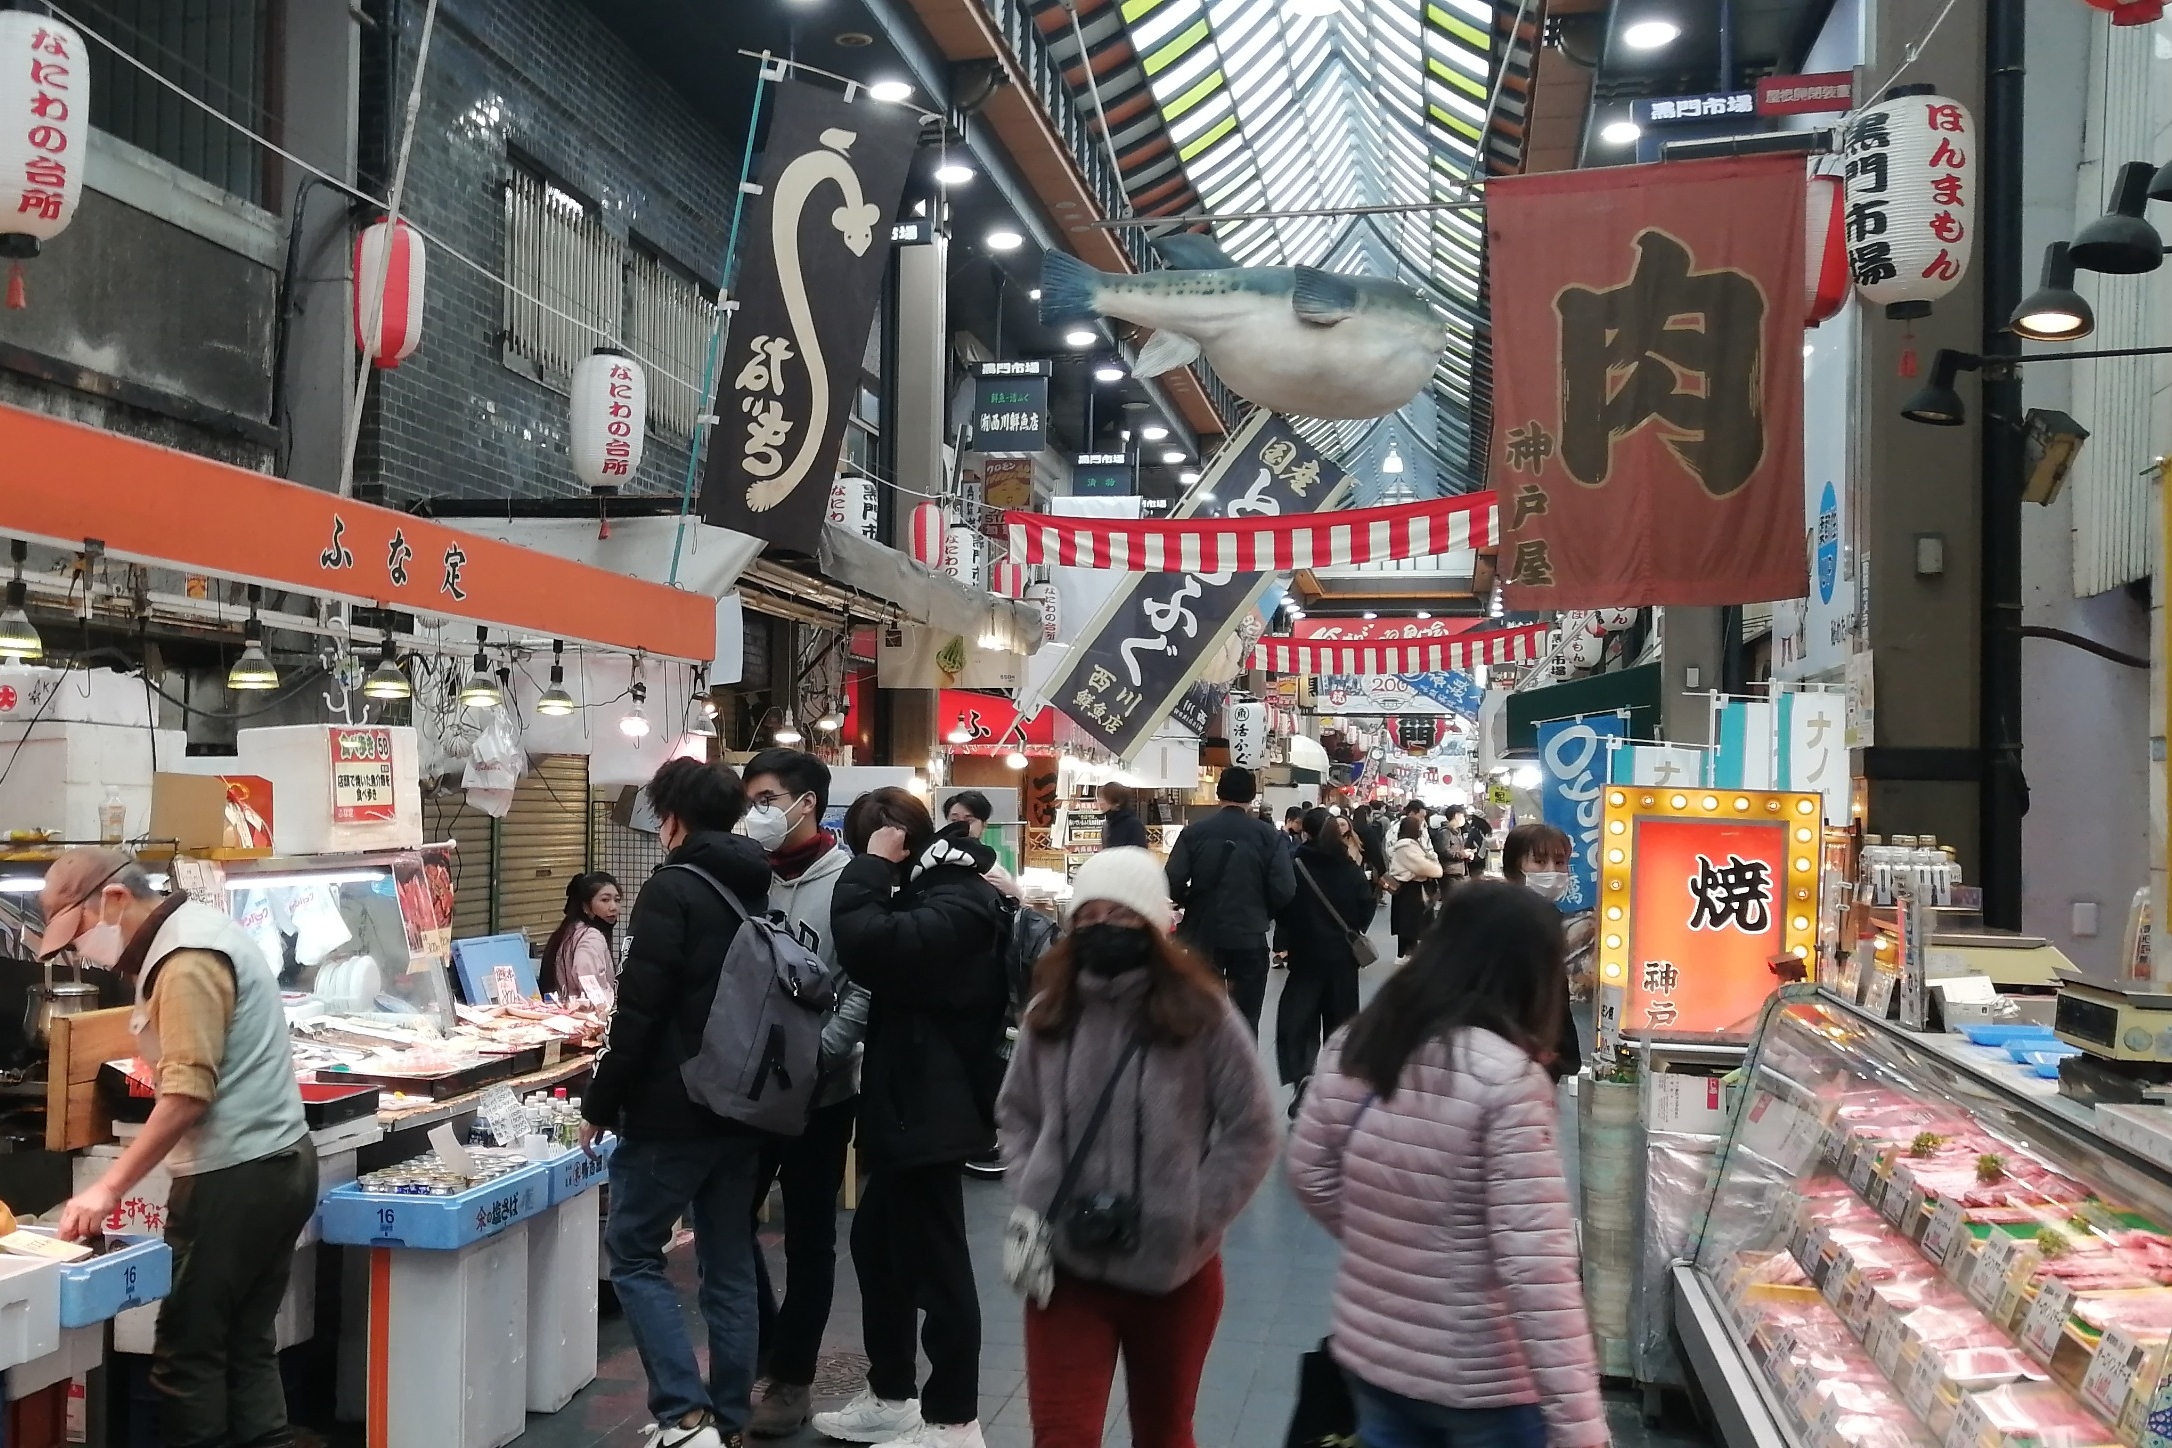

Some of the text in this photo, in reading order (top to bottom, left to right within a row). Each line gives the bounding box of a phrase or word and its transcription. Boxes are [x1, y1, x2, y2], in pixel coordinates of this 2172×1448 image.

[18, 27, 70, 221] なにわの台所
[1651, 94, 1754, 120] 黒門市場
[1845, 112, 1897, 287] 黒門市場
[1922, 103, 1966, 282] ほんまもん
[981, 361, 1040, 375] 黒門市場
[1551, 226, 1770, 500] 肉
[602, 364, 632, 476] なにわの台所
[1257, 436, 1322, 498] 国産
[1504, 420, 1556, 588] 神戸屋
[320, 513, 467, 602] ふな定
[1121, 468, 1281, 687] とふぐ
[1044, 587, 1057, 641] なにわの台所
[1072, 689, 1125, 736] 鮮魚店
[1088, 664, 1143, 718] 西川
[377, 737, 389, 756] 58
[1233, 723, 1252, 765] 活ふぐ
[356, 788, 377, 801] 食べ歩き
[1688, 853, 1774, 935] 焼
[1642, 961, 1680, 1030] 神戸
[376, 1208, 395, 1224] 16
[123, 1265, 137, 1286] 16
